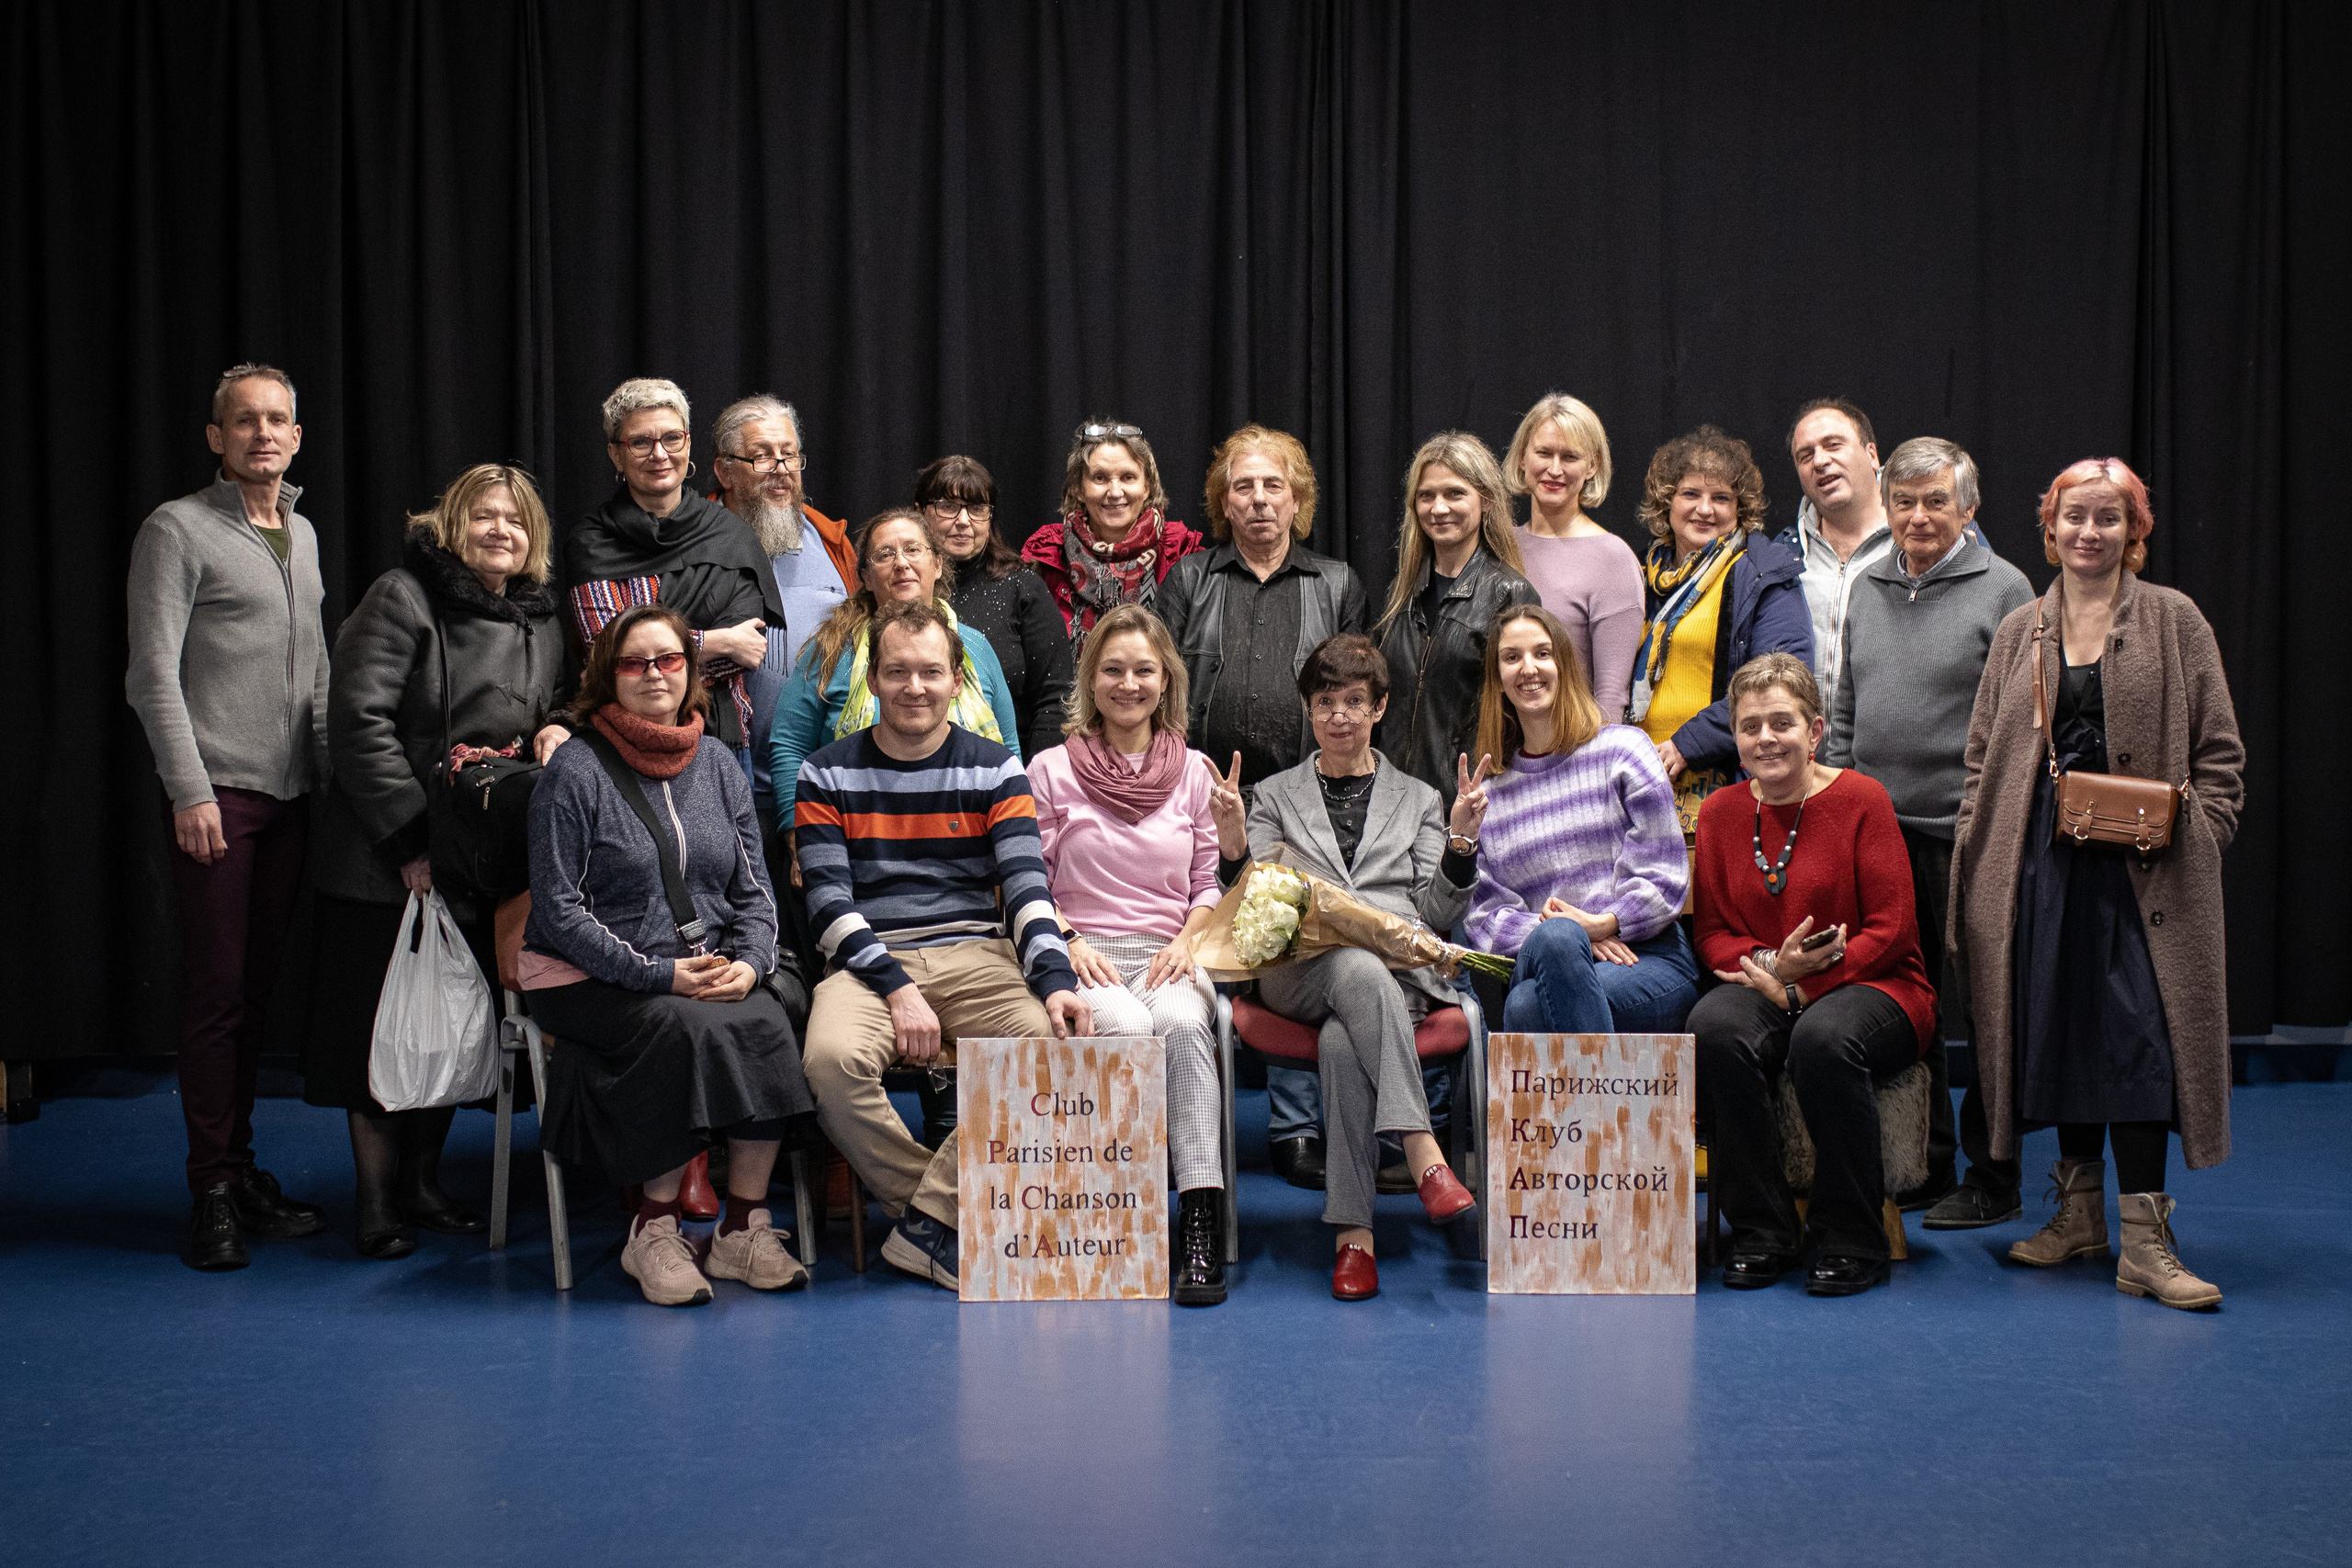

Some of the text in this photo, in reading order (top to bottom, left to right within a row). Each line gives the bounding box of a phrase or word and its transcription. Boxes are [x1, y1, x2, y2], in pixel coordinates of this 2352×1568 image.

[1511, 1070, 1679, 1100] Парижский
[1031, 1092, 1094, 1116] Club
[1510, 1118, 1582, 1148] Клуб
[988, 1138, 1133, 1164] Parisien de
[1509, 1166, 1668, 1197] Авторской
[990, 1186, 1136, 1210] la Chanson
[1510, 1215, 1598, 1239] Песни
